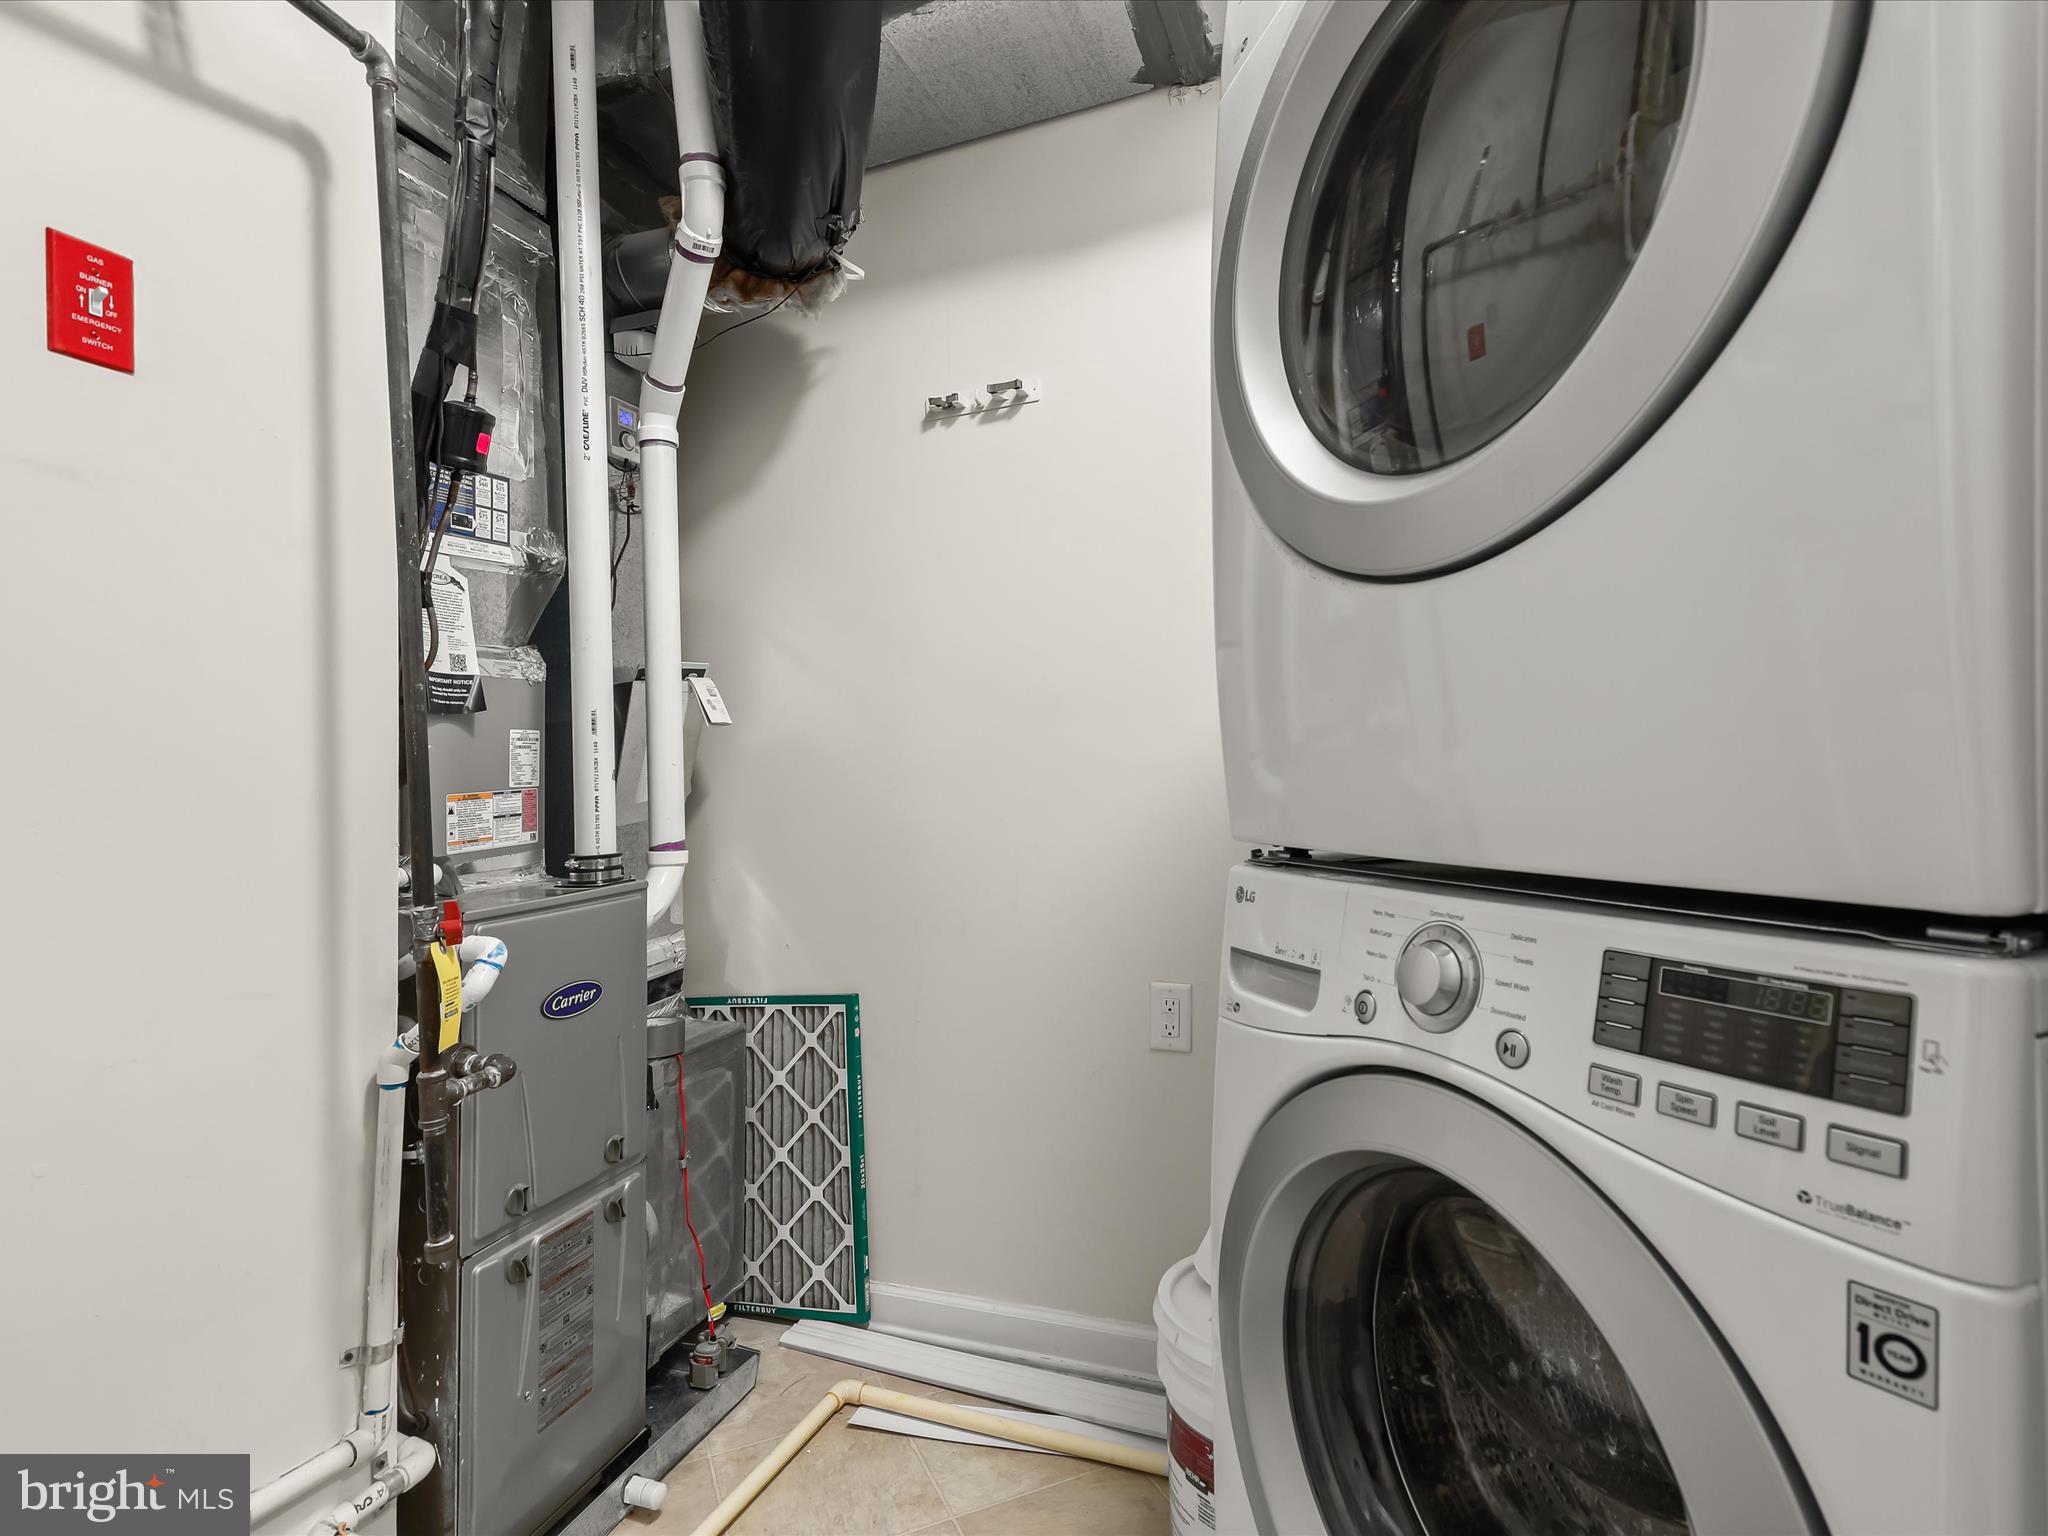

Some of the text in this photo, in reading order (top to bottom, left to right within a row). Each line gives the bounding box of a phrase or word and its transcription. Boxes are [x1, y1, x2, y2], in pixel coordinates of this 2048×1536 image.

[86, 254, 104, 266] GAS
[79, 271, 113, 289] BURNER
[76, 284, 86, 294] ON
[578, 295, 585, 306] 40
[105, 310, 118, 319] OFF
[578, 306, 586, 322] SCH
[72, 312, 122, 334] EMERGENCY
[82, 336, 114, 352] SWITCH
[1245, 890, 1256, 903] LG
[1510, 932, 1537, 944] Delicates
[1513, 956, 1534, 966] Towels
[1495, 978, 1530, 992] Speed Wash
[552, 988, 596, 1011] Carrier
[1490, 1006, 1526, 1022] Downloaded
[1600, 1073, 1623, 1086] Wash
[1674, 1092, 1695, 1106] Spin
[1600, 1102, 1614, 1111] Cold
[1616, 1106, 1636, 1118] Rinses
[1670, 1101, 1698, 1117] Speed
[1758, 1114, 1778, 1128] Soil
[1753, 1124, 1781, 1140] Level
[1844, 1140, 1882, 1160] Signal
[734, 1304, 777, 1314] FILTERBUY
[1854, 1293, 1931, 1328] Direct Drive
[1856, 1321, 1928, 1381] 10
